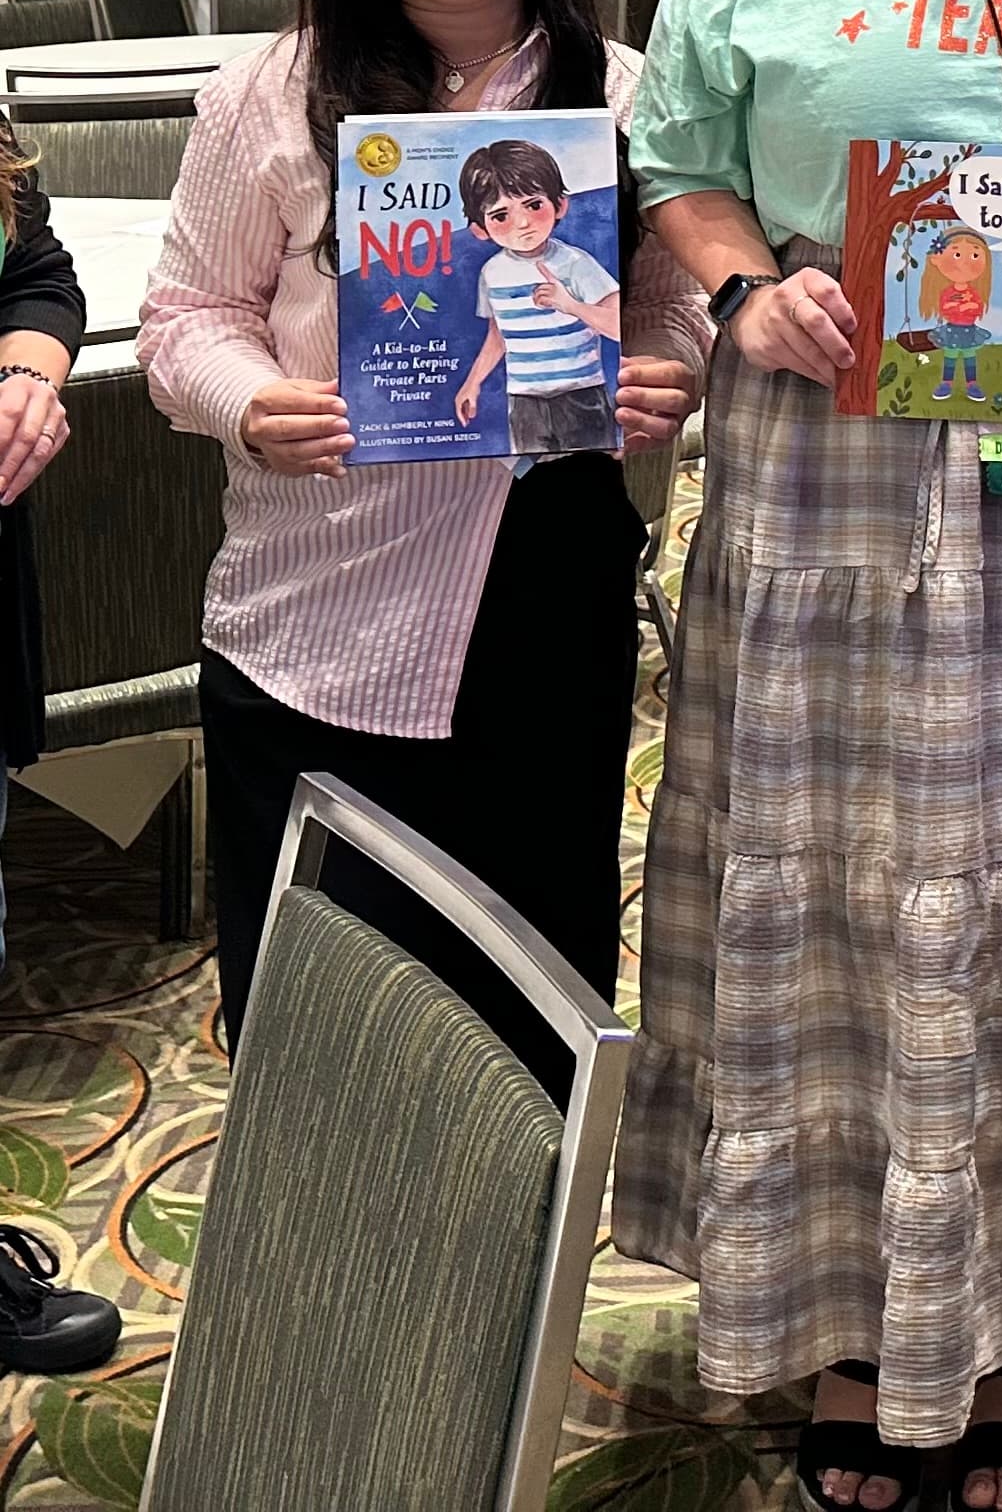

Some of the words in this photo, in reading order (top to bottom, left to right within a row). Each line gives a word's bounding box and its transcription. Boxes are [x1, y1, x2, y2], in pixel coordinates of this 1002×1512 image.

[959, 174, 968, 194] I
[358, 185, 368, 211] I
[380, 182, 452, 211] SAID
[980, 206, 1002, 228] to
[360, 219, 453, 280] NO!
[372, 344, 380, 356] A
[385, 339, 447, 355] Kid-to-Kid
[360, 358, 394, 372] Guide
[397, 360, 409, 370] to
[413, 356, 460, 372] Keeping
[373, 374, 415, 387] Private
[418, 373, 447, 385] Parts
[390, 389, 431, 402] Private
[360, 424, 382, 432] ZACK
[392, 421, 432, 430] KIMBERLY
[434, 419, 455, 427] KING
[360, 437, 412, 447] ILLUSTRATED
[414, 436, 425, 444] BY
[426, 434, 453, 444] SUSAN
